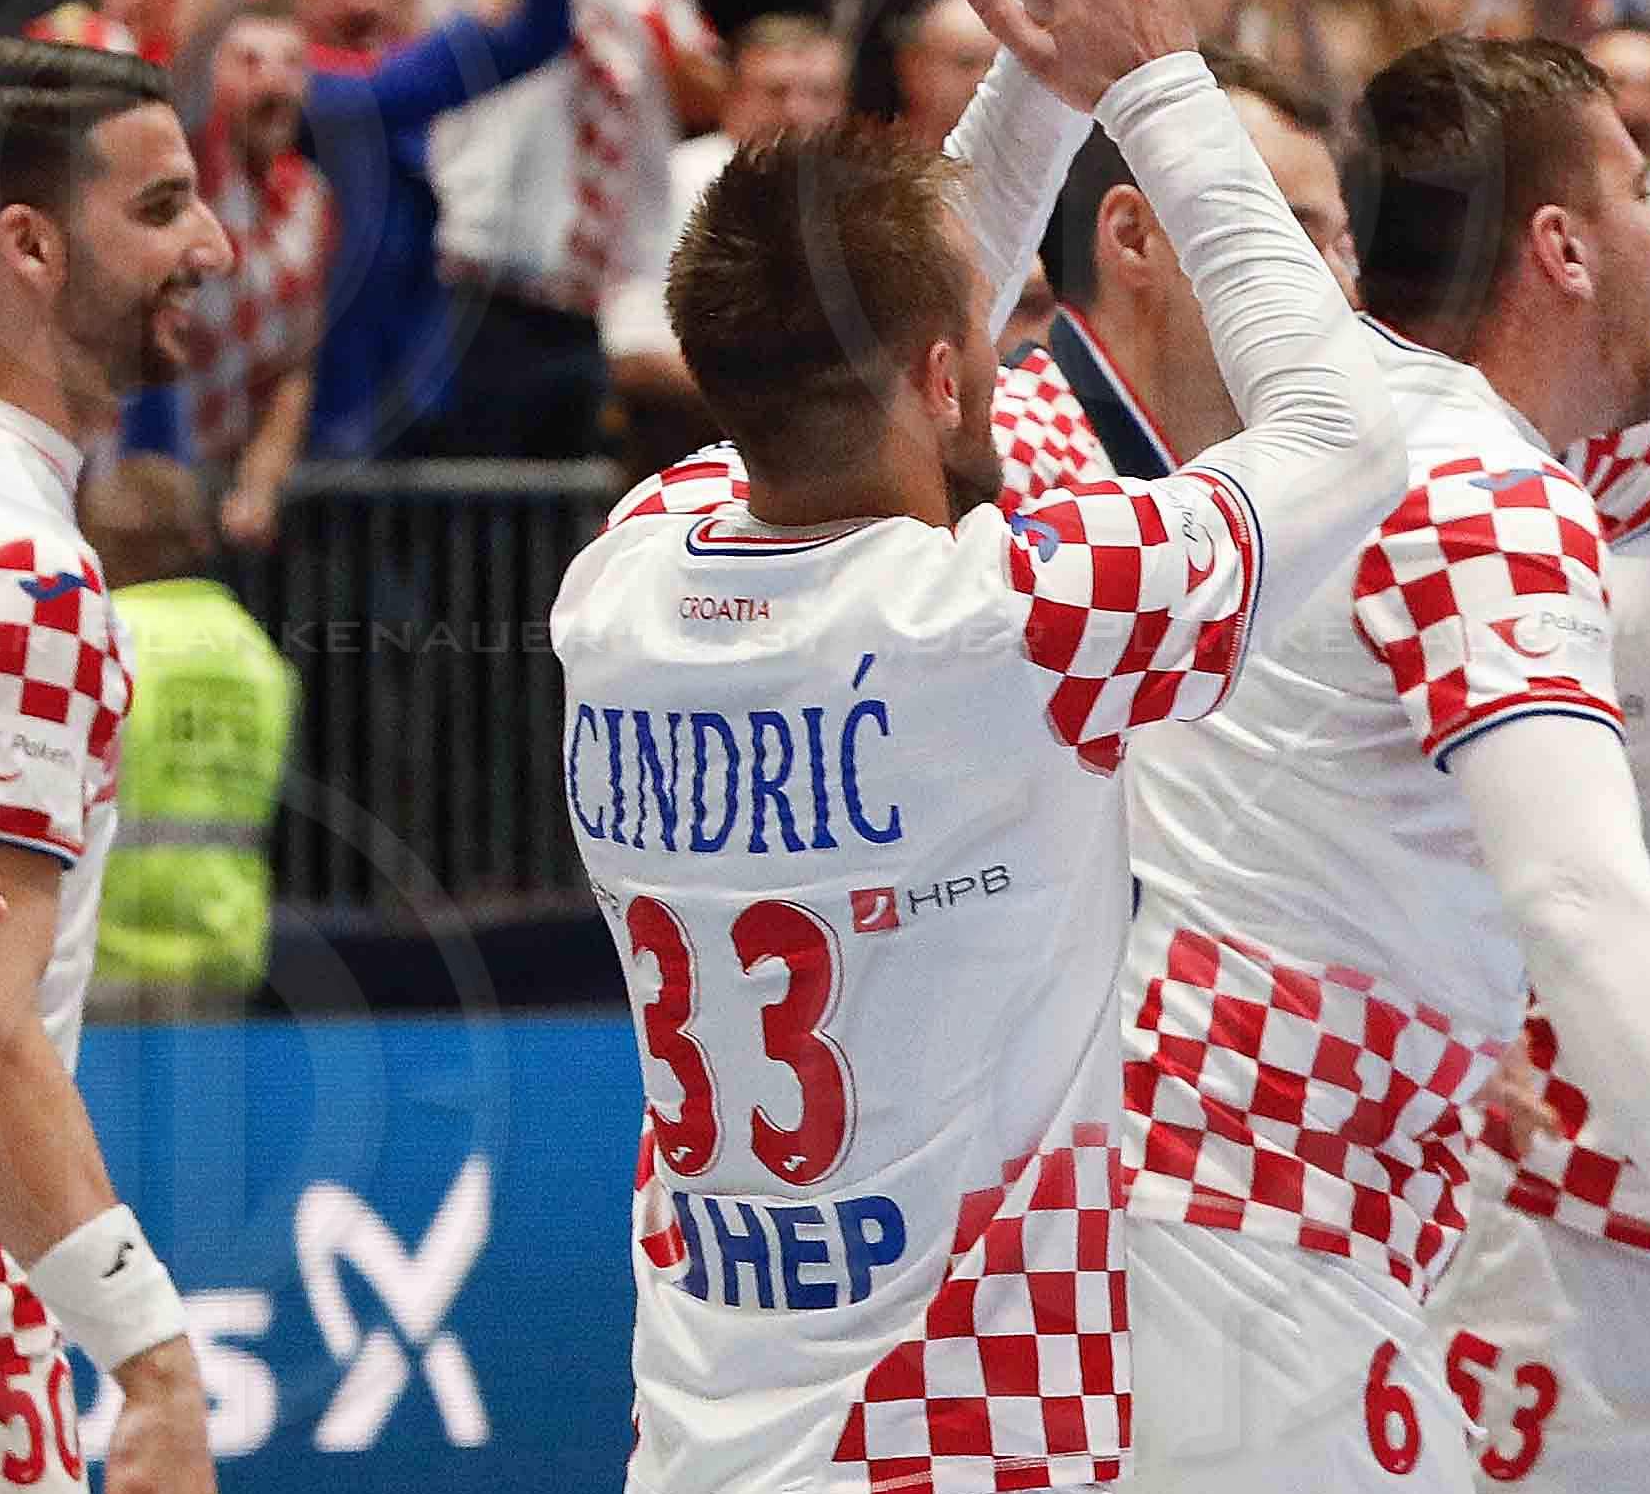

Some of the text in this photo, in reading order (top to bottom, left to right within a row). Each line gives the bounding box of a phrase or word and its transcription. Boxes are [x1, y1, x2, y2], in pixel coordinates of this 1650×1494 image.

[681, 595, 773, 623] CROATIA
[570, 652, 904, 854] CINDRIĆ
[906, 863, 1013, 916] HPB
[624, 895, 859, 1189] 33
[723, 1194, 909, 1311] HEP
[1363, 1339, 1419, 1475] 6
[1446, 1329, 1561, 1482] 53
